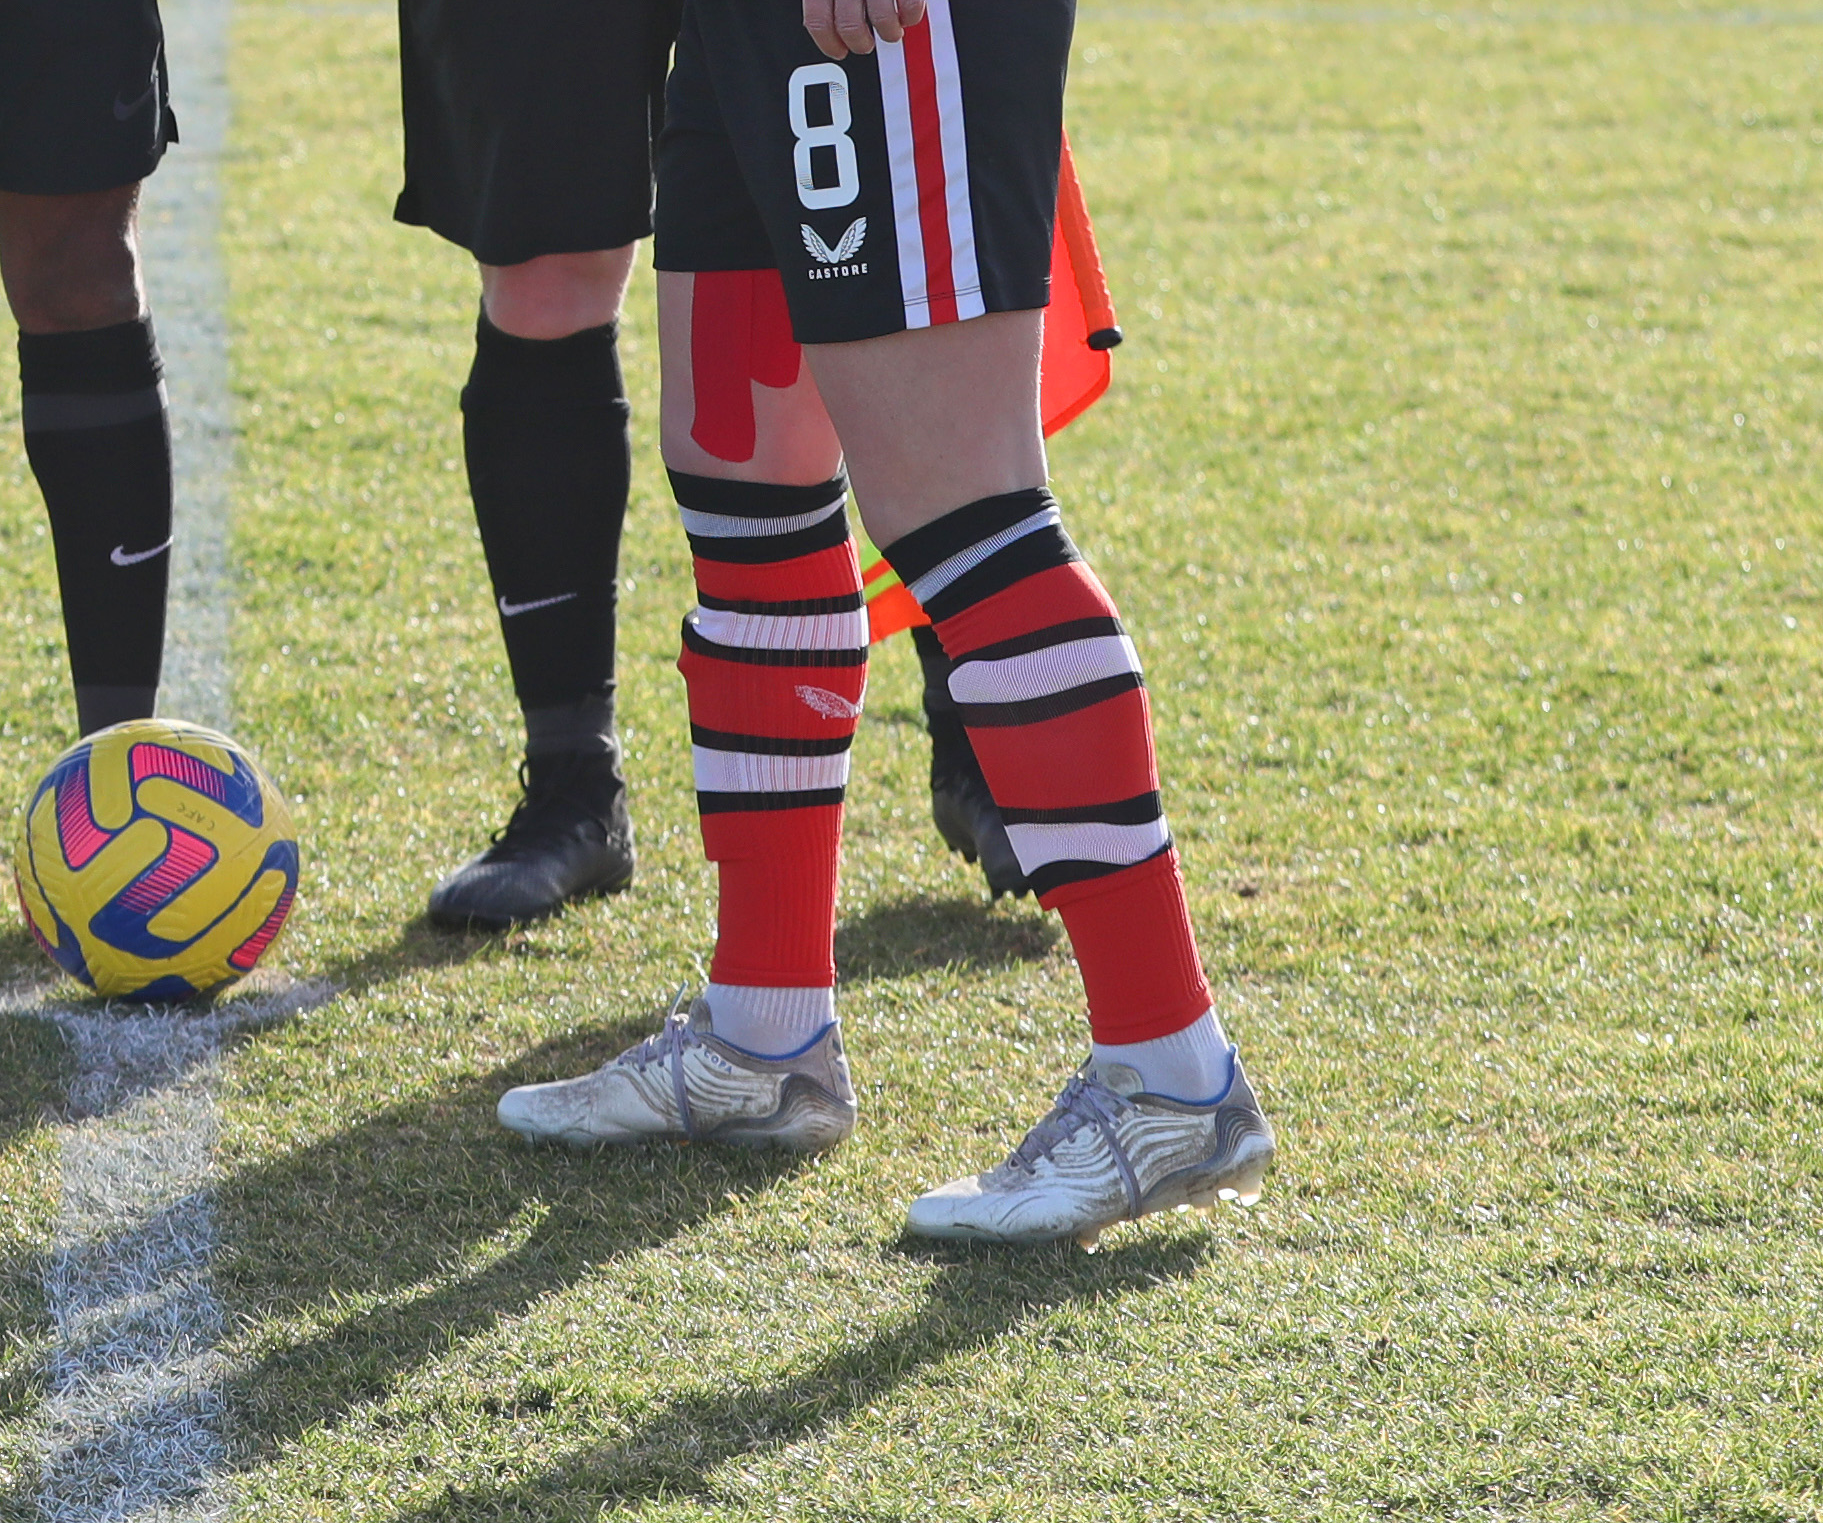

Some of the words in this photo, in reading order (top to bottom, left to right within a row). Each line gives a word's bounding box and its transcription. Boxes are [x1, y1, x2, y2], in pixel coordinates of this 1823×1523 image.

[788, 62, 860, 211] 8
[808, 262, 869, 280] CASTORE
[703, 1049, 733, 1075] COPA
